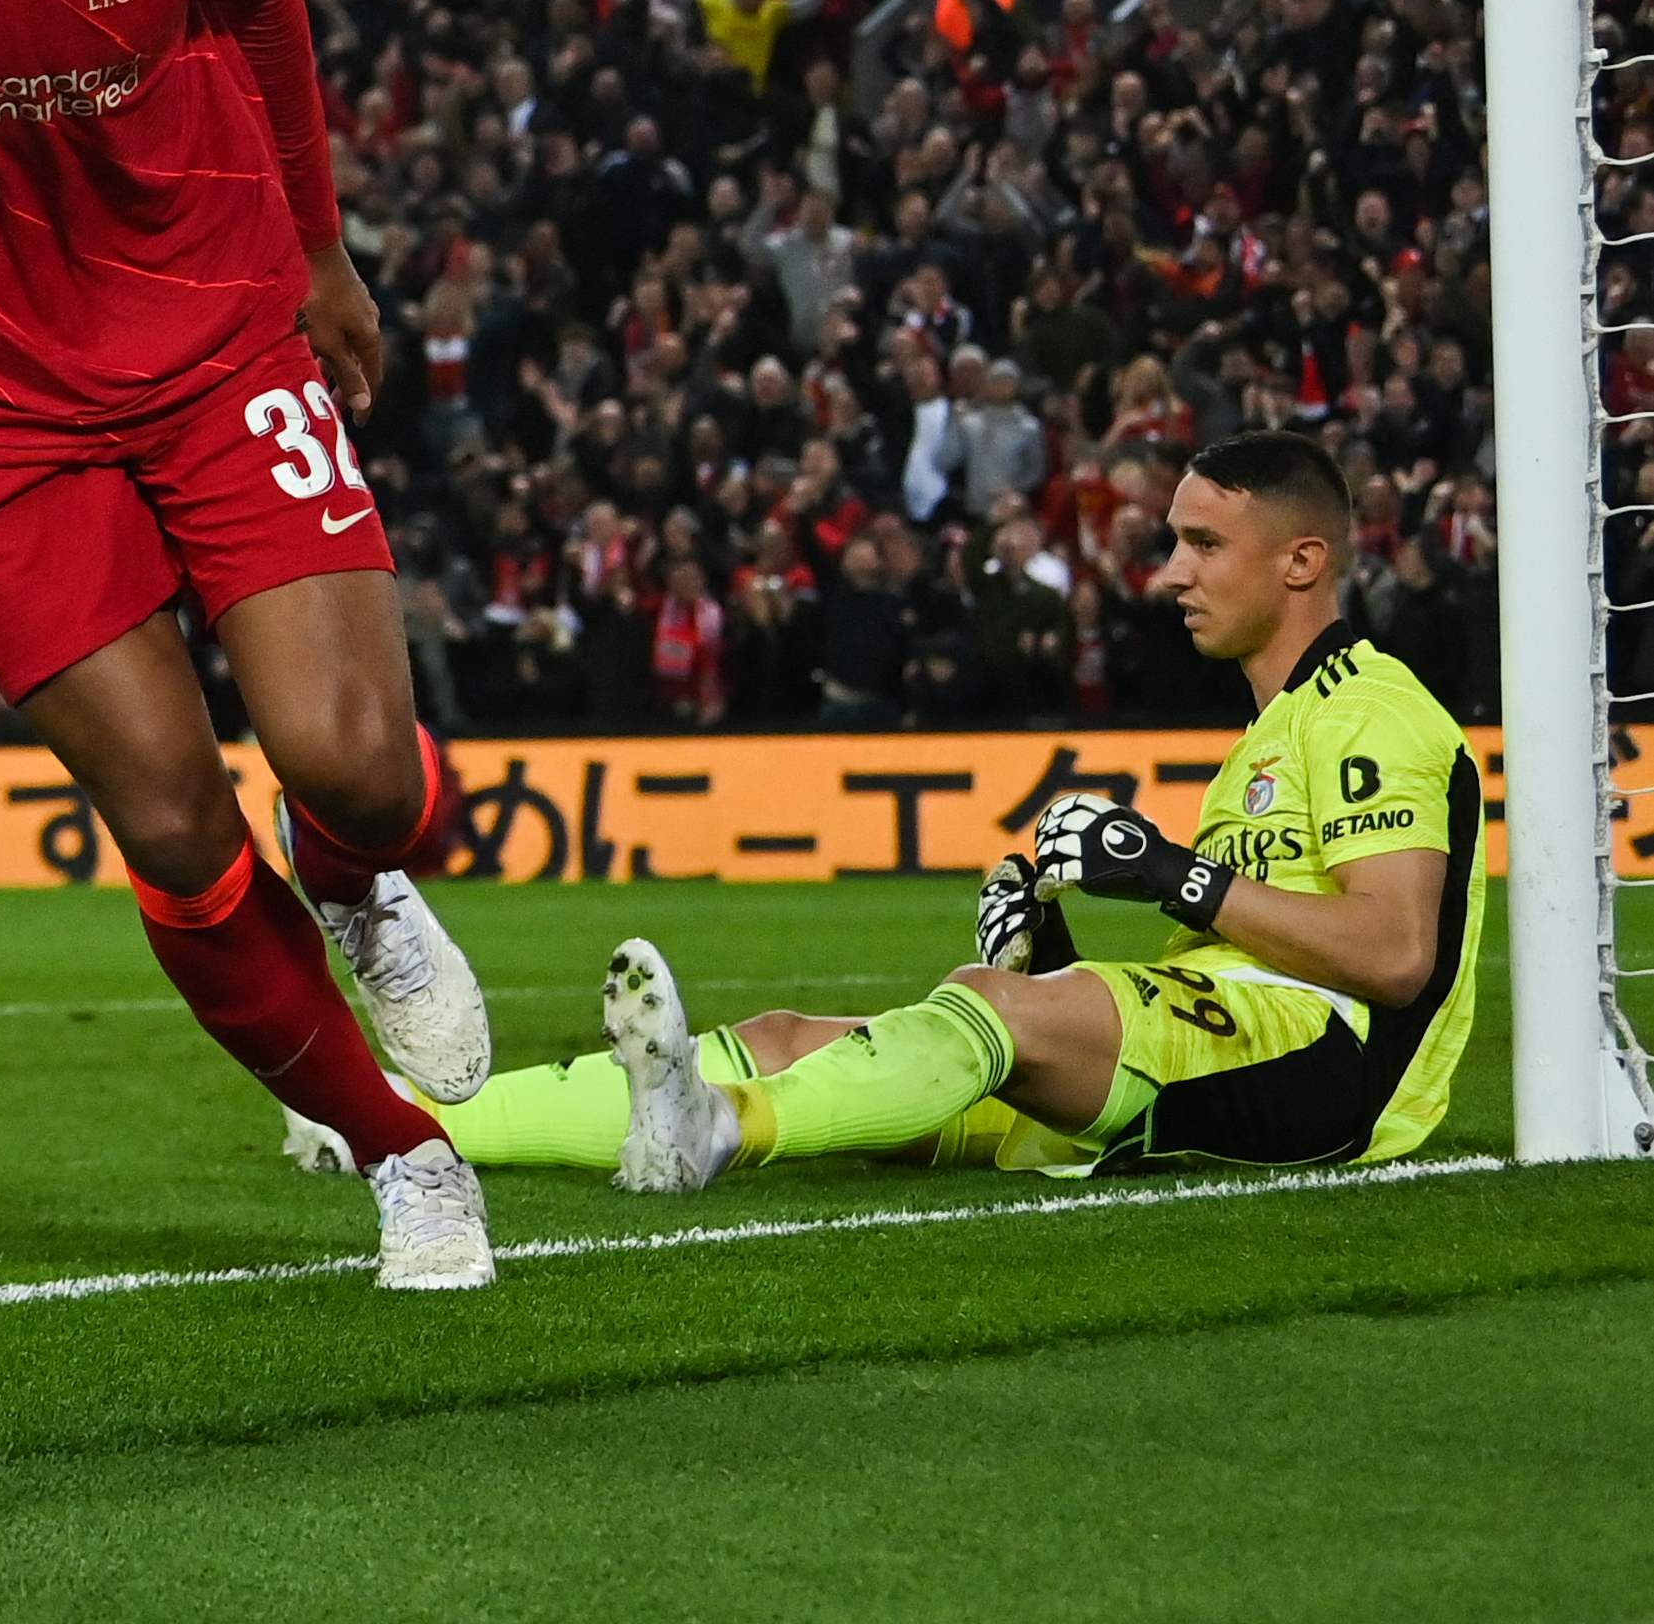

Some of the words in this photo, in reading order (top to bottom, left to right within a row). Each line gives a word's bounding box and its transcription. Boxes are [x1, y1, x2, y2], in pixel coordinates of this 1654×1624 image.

[245, 380, 372, 499] 32
[1193, 826, 1304, 871] irates
[1322, 808, 1414, 845] BETANO
